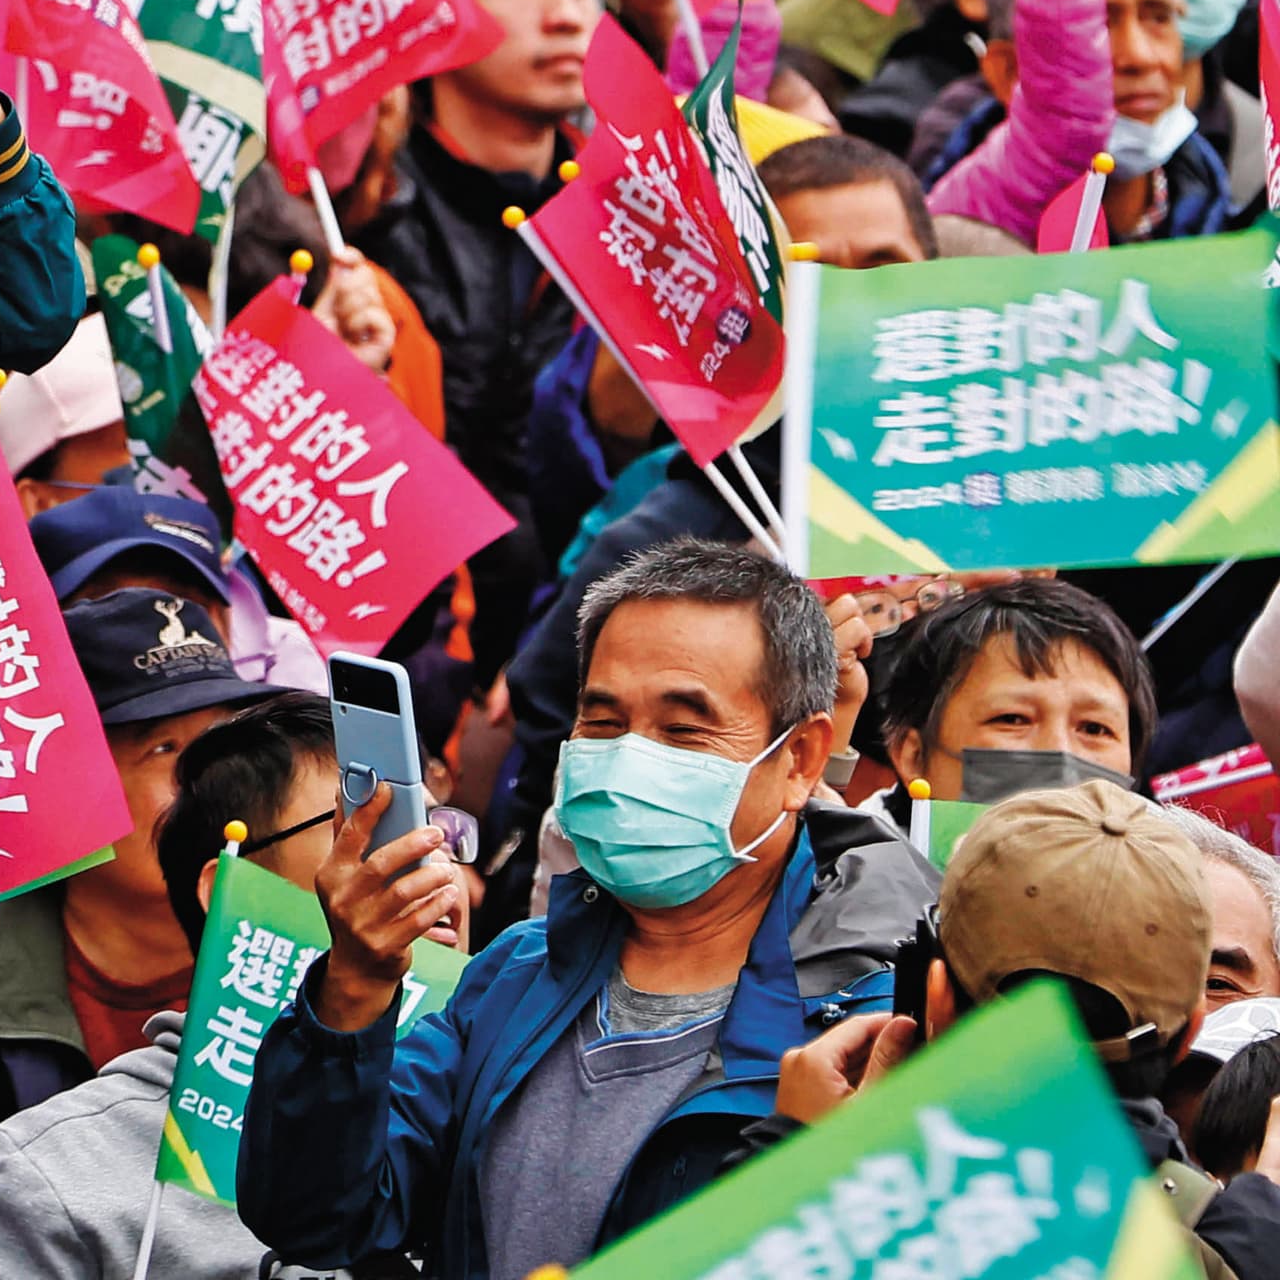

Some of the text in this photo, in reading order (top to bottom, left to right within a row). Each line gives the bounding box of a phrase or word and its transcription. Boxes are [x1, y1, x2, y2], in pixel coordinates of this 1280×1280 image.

[200, 390, 388, 588] 對的路!
[178, 1087, 245, 1132] 2024
